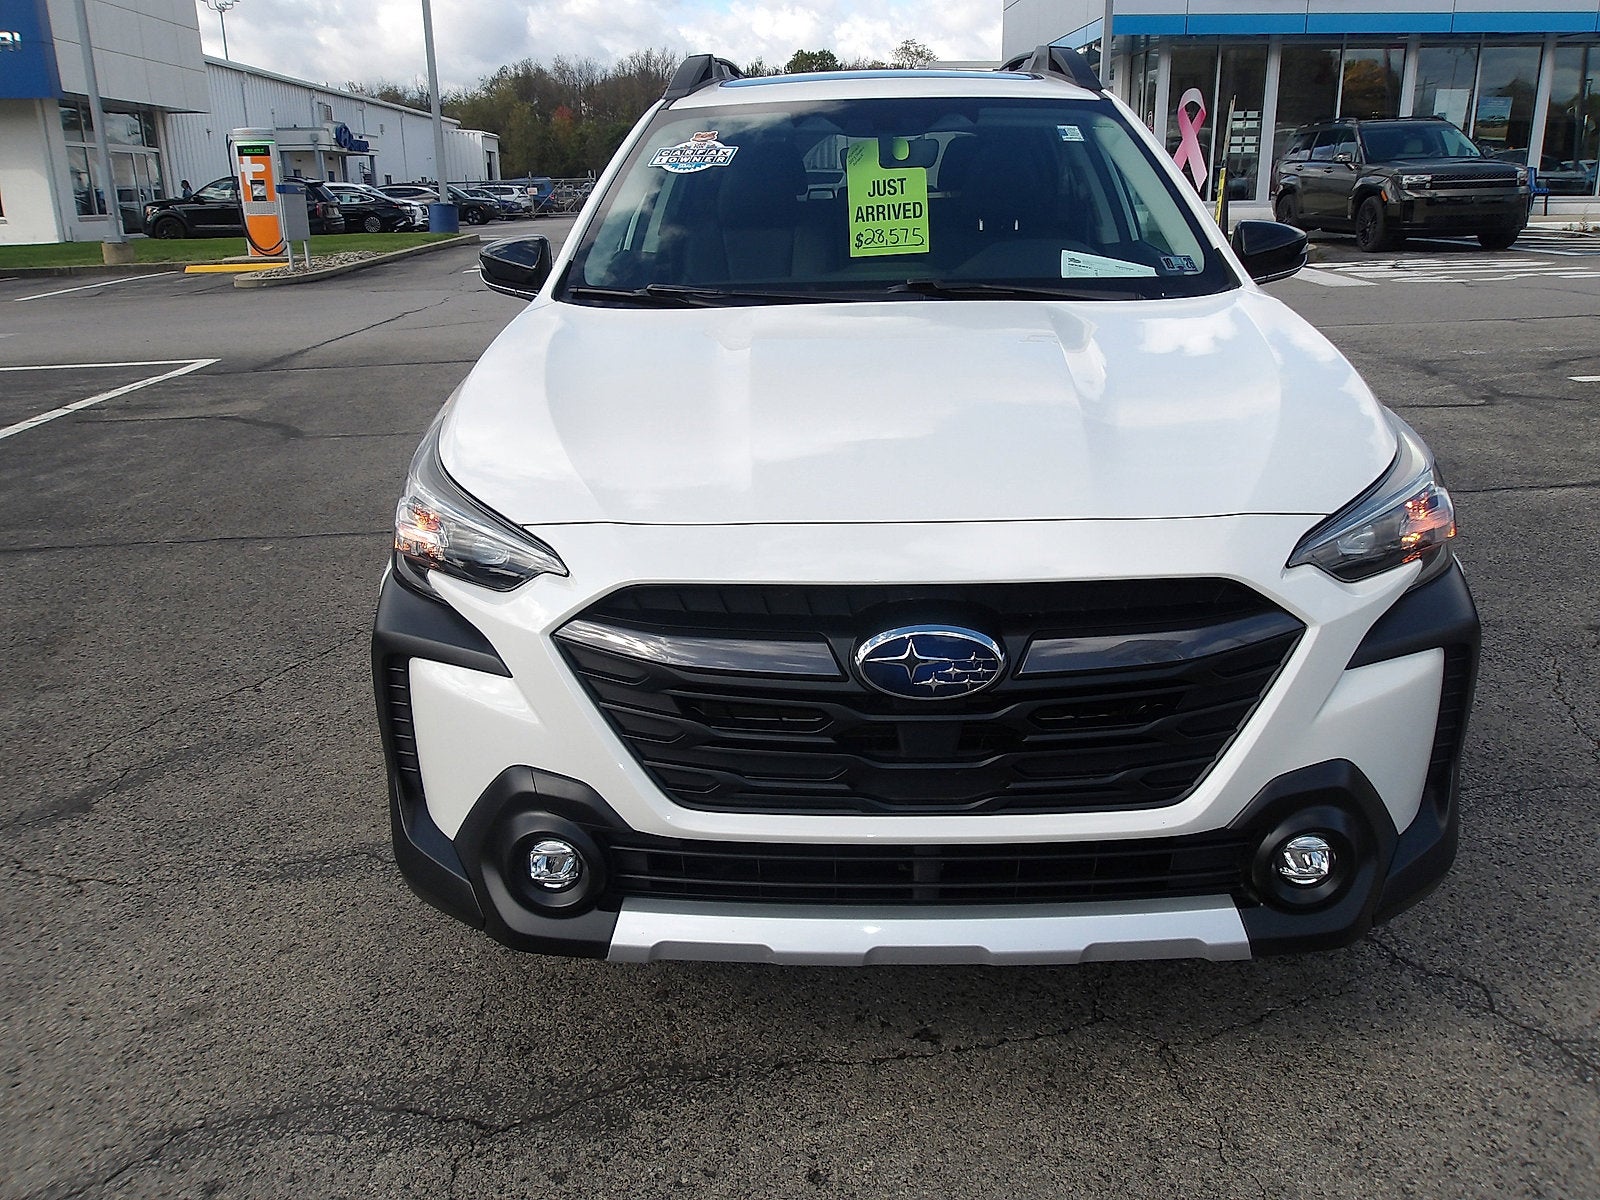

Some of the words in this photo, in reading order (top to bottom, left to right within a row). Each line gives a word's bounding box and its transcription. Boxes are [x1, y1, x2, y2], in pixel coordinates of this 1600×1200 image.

[660, 148, 731, 157] CARFAX
[667, 156, 727, 164] OWNER
[867, 177, 907, 198] JUST
[854, 201, 924, 223] ARRIVED
[854, 227, 925, 250] $28,575
